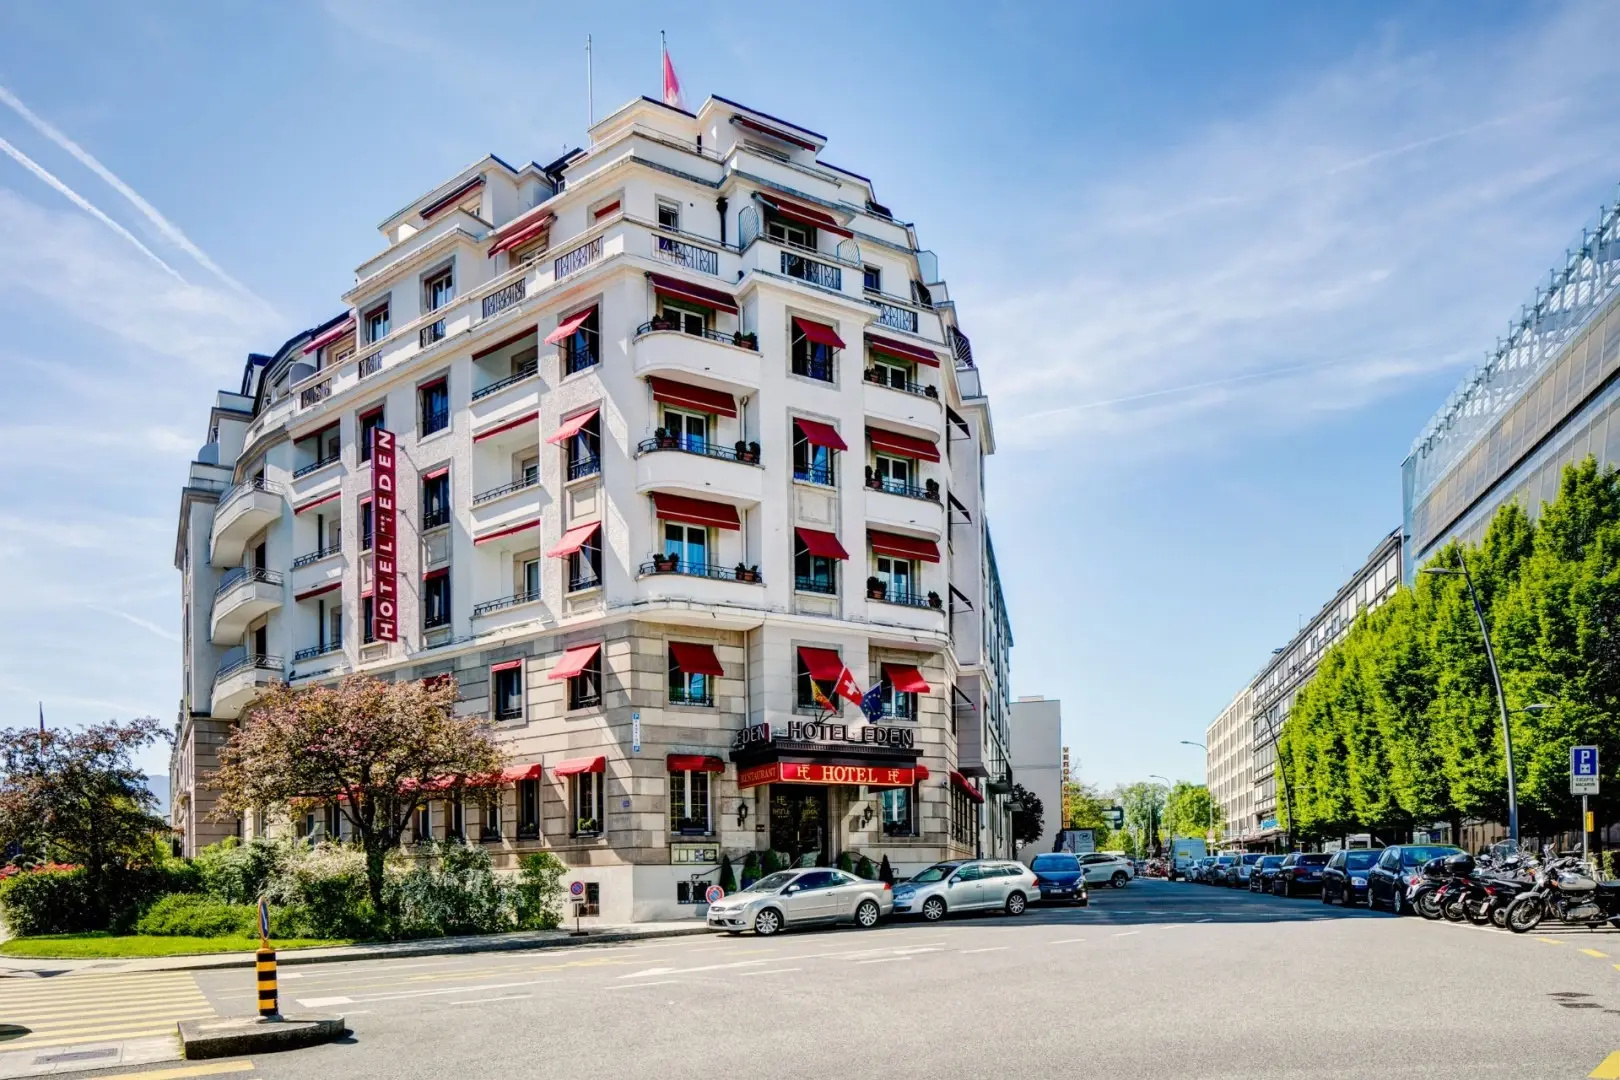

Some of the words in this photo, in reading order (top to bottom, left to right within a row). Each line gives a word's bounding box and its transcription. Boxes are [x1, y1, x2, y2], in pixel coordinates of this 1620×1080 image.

[378, 430, 393, 511] EDEN
[379, 541, 394, 639] HOTEL
[736, 723, 766, 746] EDEN
[788, 720, 855, 741] HOTEL
[862, 726, 914, 748] EDEN
[1581, 750, 1590, 764] P
[740, 767, 777, 783] RESTAURANT
[821, 764, 878, 783] HOTEL
